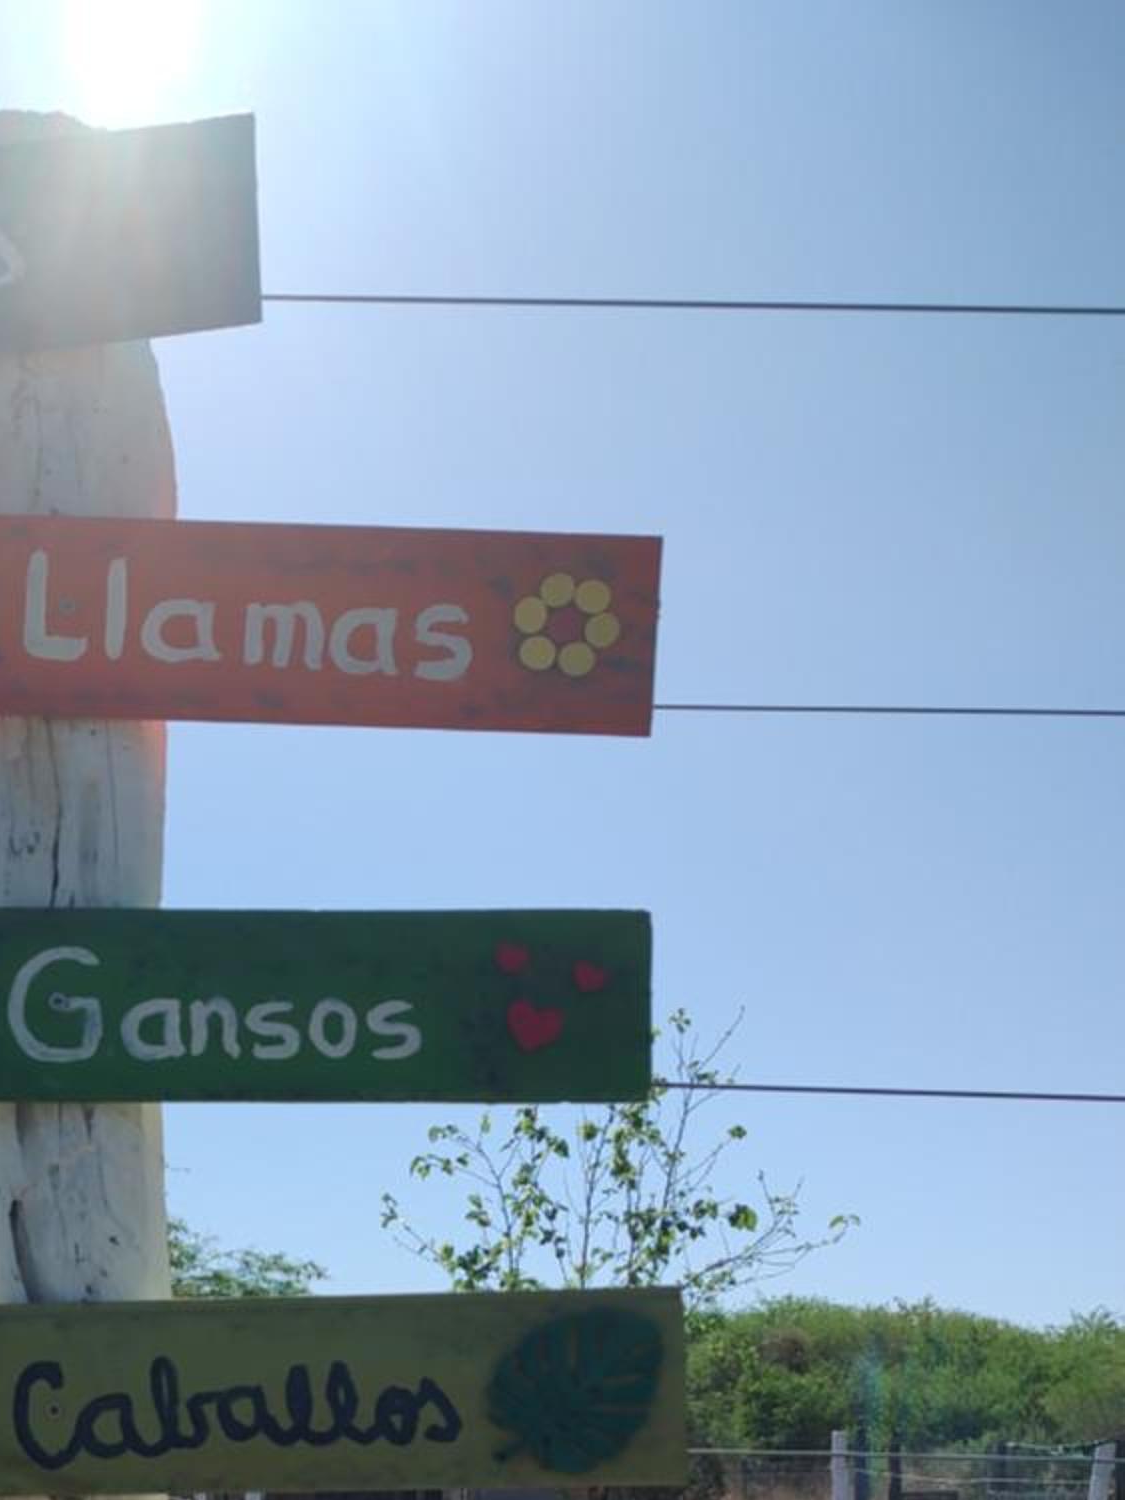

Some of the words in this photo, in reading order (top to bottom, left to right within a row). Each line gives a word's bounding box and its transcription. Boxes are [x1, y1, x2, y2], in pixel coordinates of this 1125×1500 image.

[22, 549, 473, 681] Llamas
[7, 946, 422, 1063] Gansos
[12, 1356, 463, 1470] Caballos
